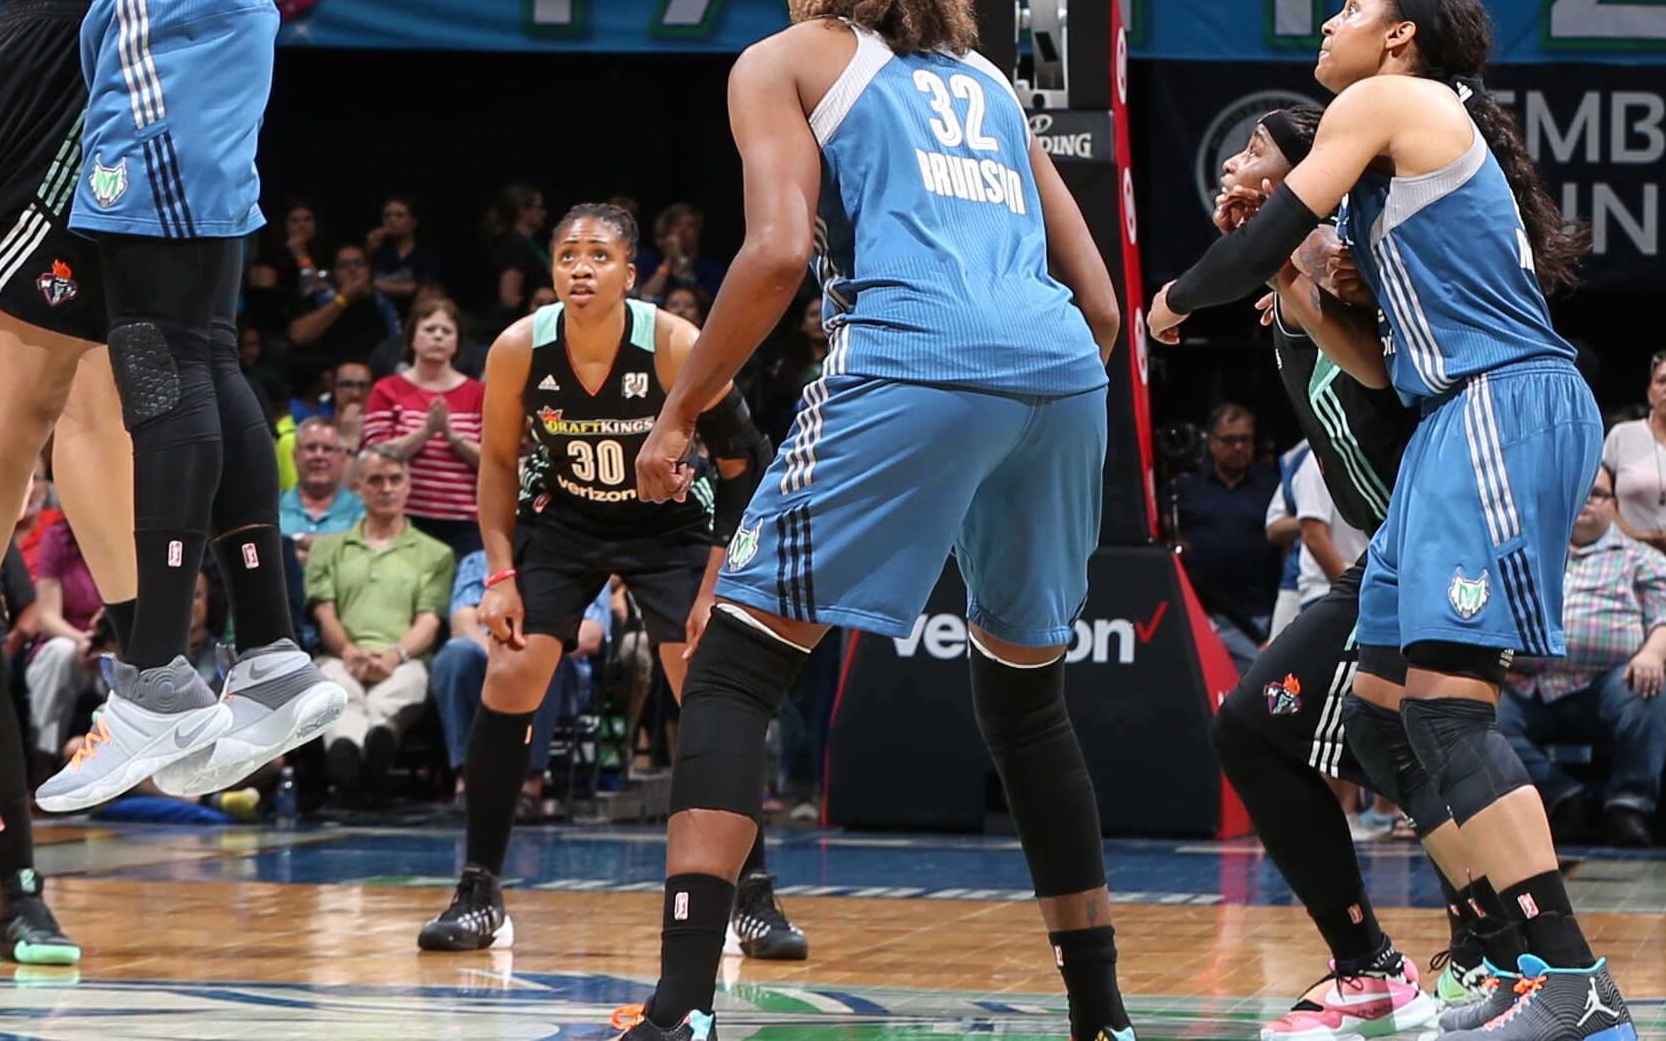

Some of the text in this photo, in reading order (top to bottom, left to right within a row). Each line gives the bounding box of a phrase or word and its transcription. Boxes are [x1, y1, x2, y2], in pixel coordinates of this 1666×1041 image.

[912, 68, 999, 152] 32
[544, 418, 655, 434] DRAFTKINGS
[566, 439, 627, 486] 30
[556, 474, 638, 503] verizon
